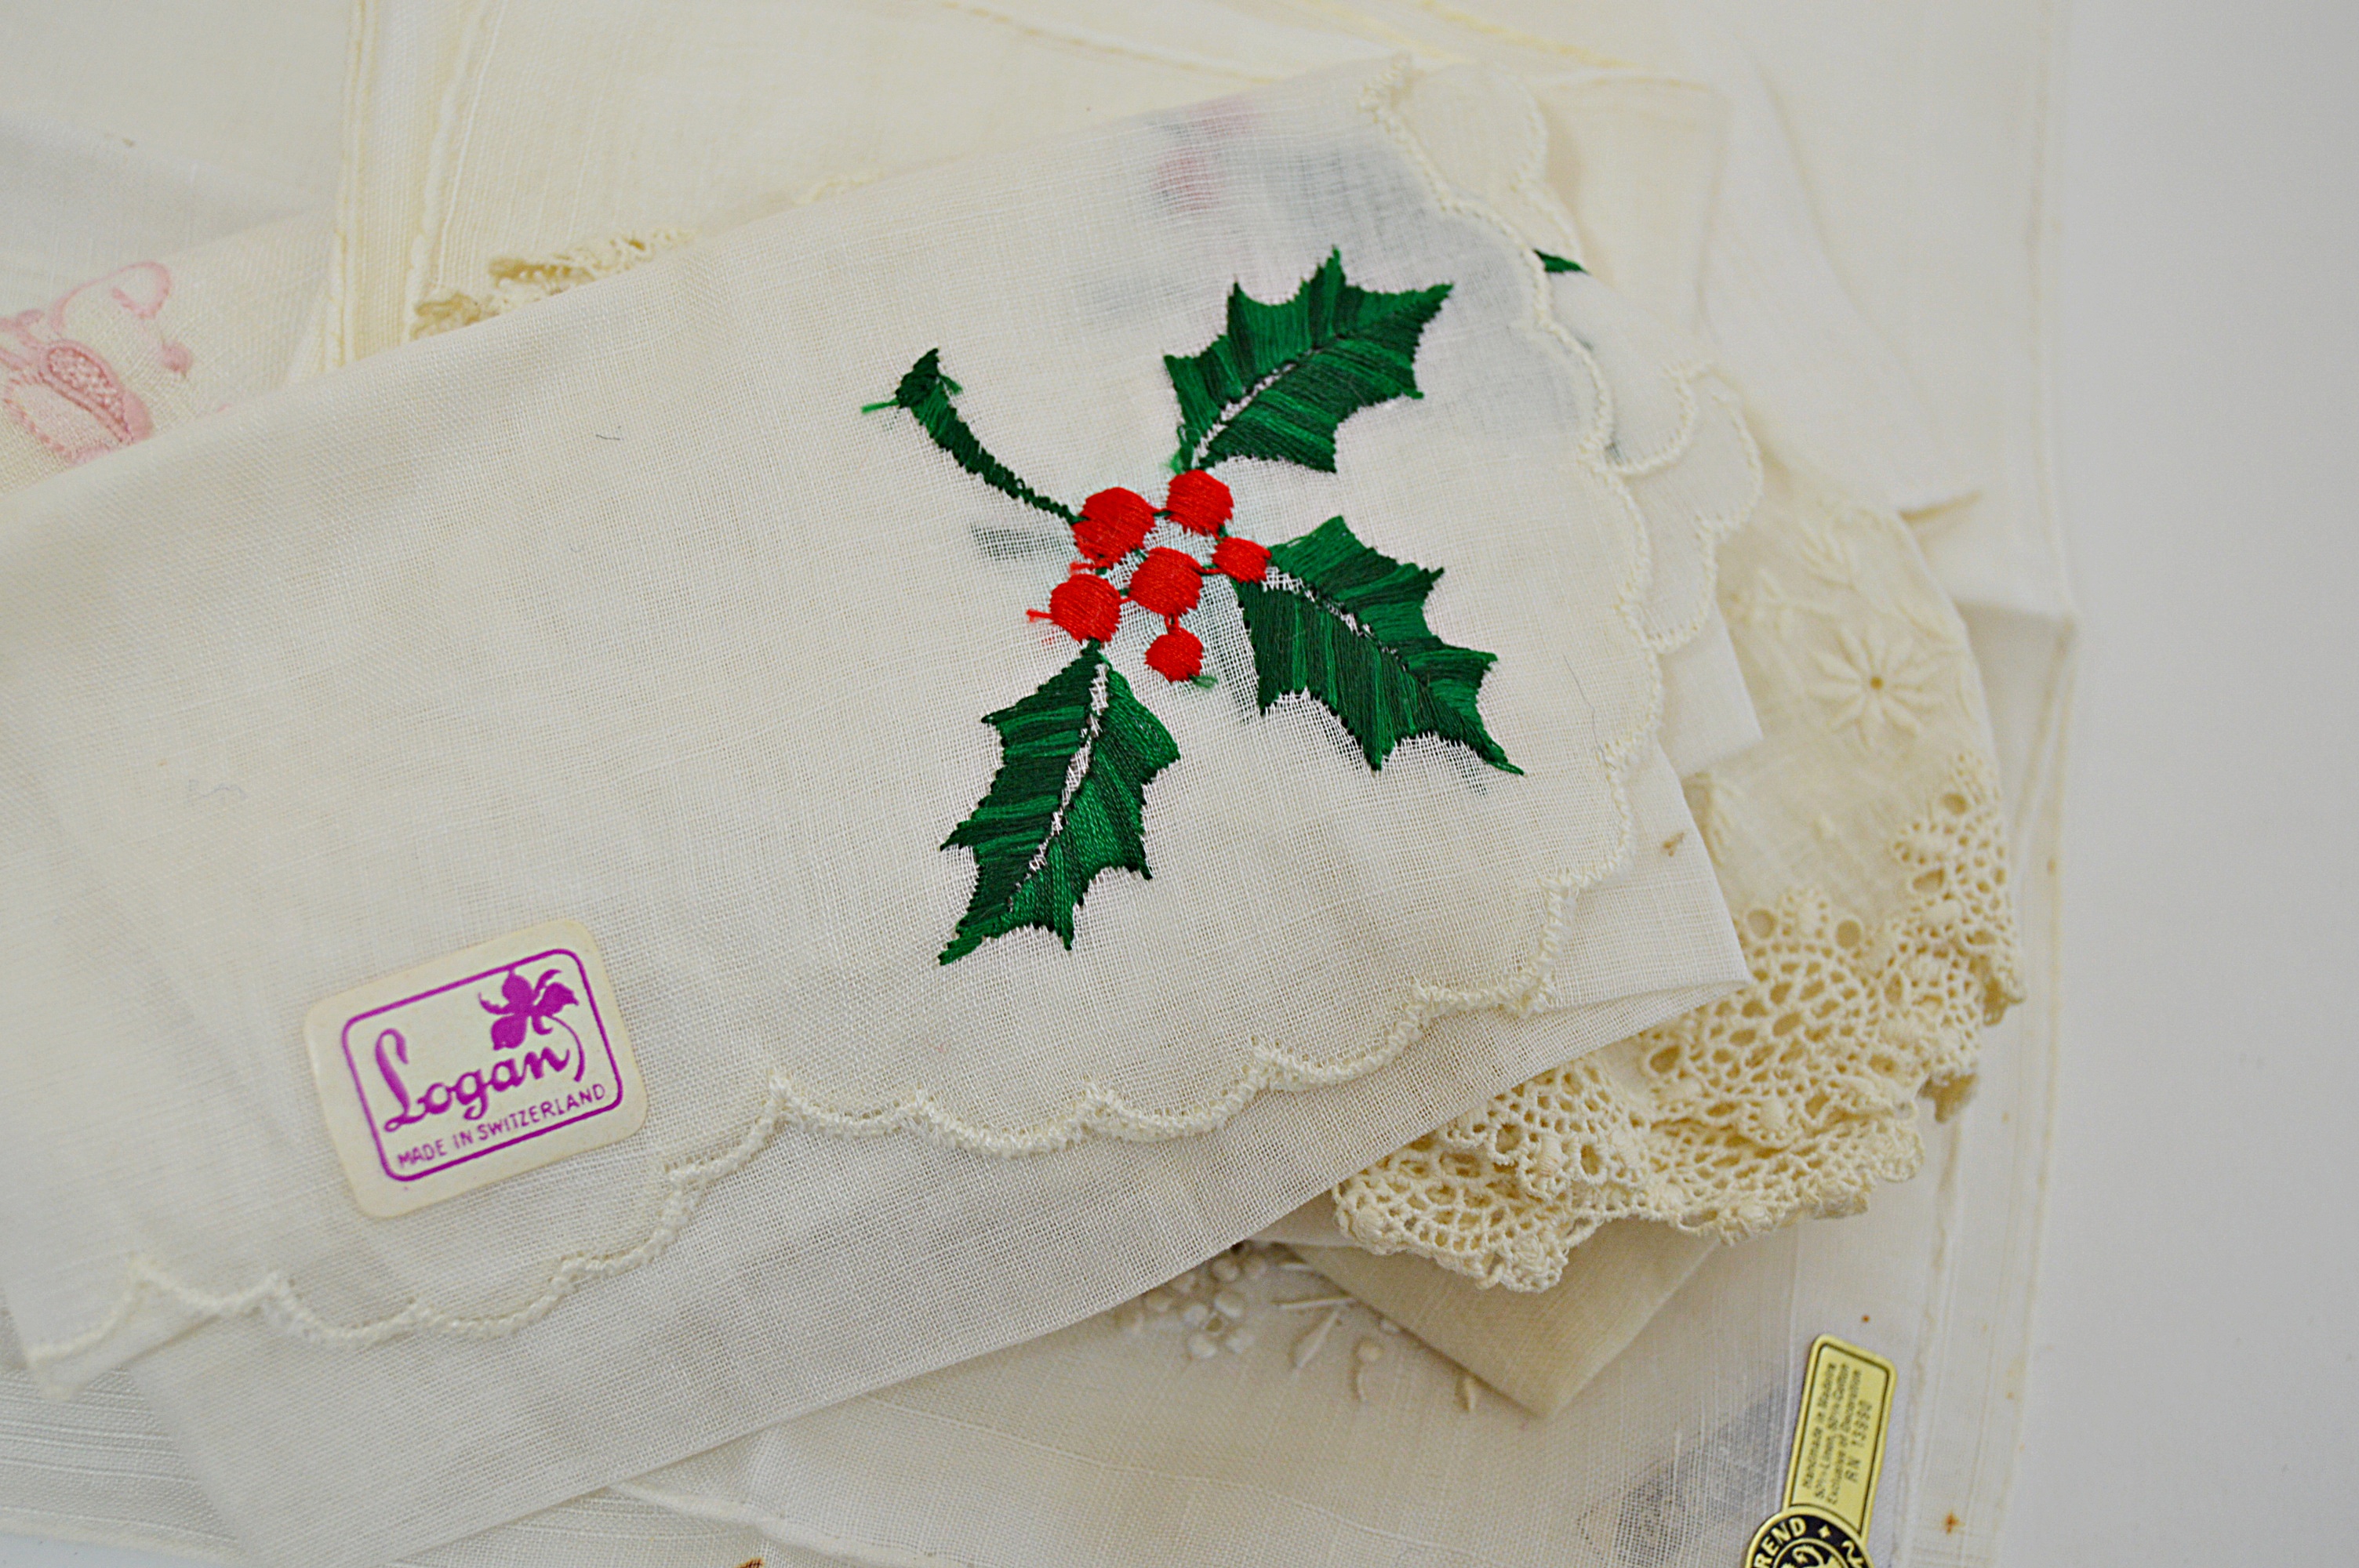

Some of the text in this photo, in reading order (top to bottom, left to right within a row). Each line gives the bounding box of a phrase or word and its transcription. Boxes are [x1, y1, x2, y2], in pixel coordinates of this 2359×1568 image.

[375, 1028, 570, 1133] Logan
[398, 1083, 605, 1168] MADE IN SWITZERLAND
[1843, 1457, 1860, 1483] RN
